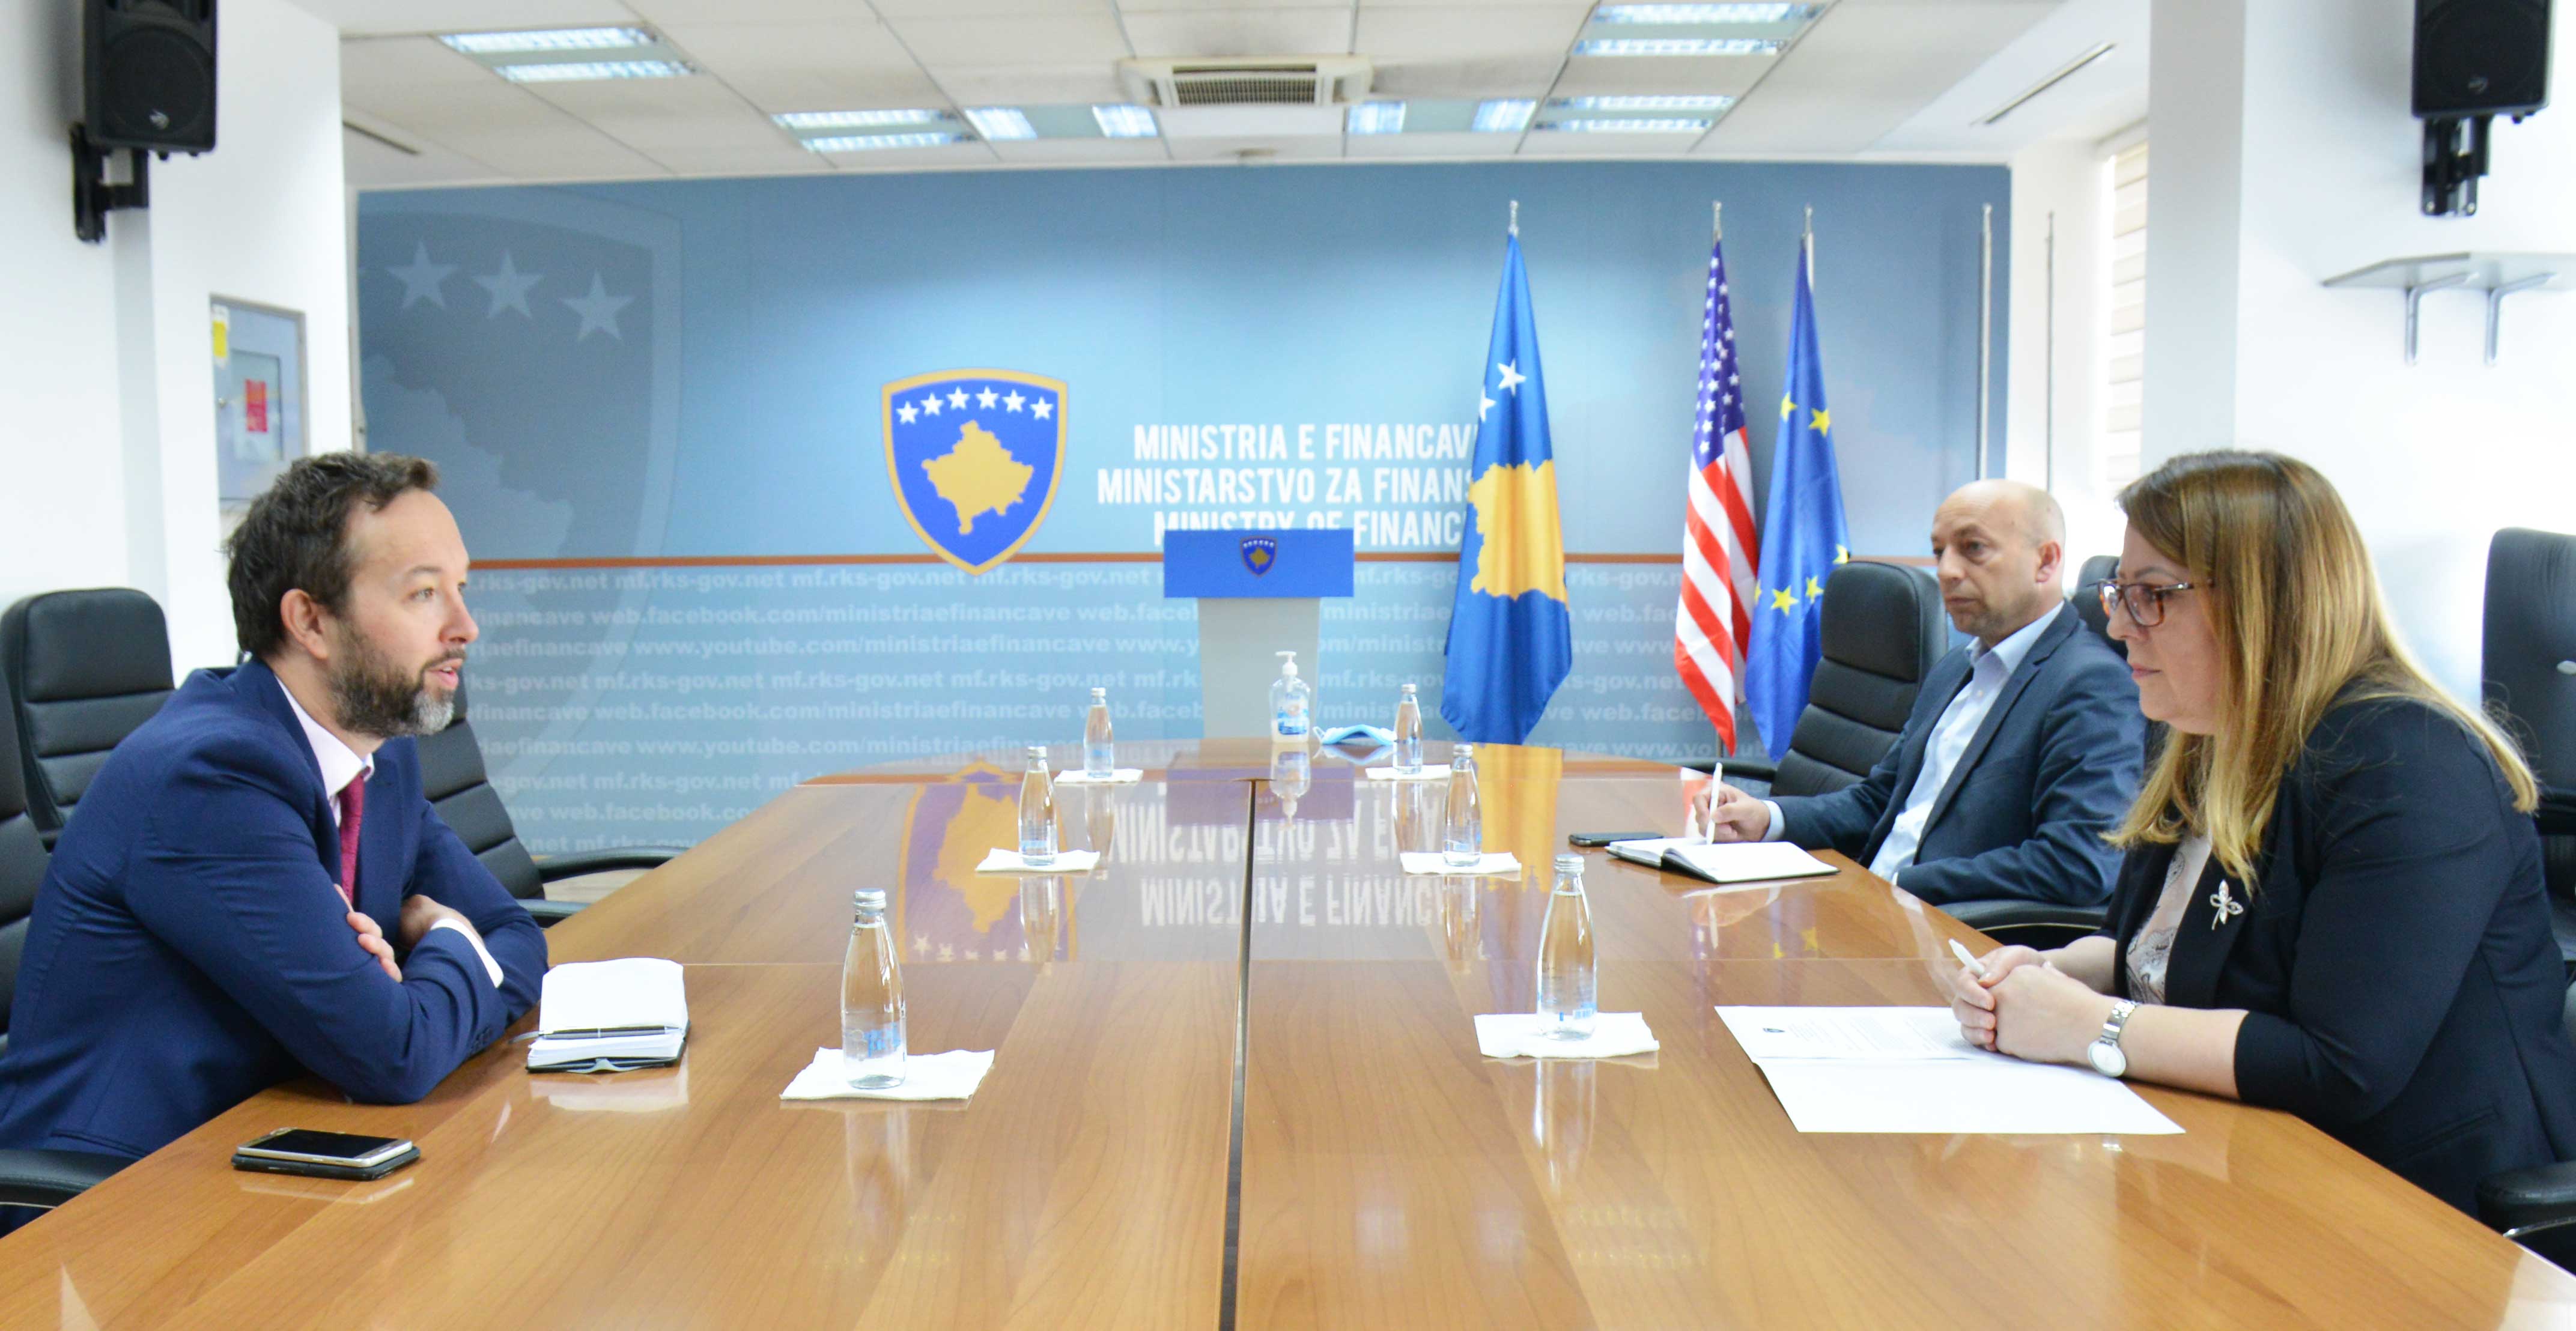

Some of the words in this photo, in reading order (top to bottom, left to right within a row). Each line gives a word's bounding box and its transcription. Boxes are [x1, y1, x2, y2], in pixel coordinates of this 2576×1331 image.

[1134, 424, 1288, 461] MINISTRIA
[1298, 423, 1316, 460] E
[1325, 423, 1478, 460] FINANCAV
[1097, 467, 1316, 504] MINISTARSTVO
[1325, 467, 1364, 503] ZA
[1353, 511, 1466, 546] FINANC
[616, 570, 783, 592] mf.rks-gov.net
[792, 568, 967, 590] mf.rks-gov.net
[591, 602, 1071, 625] web.facebook.com/ministriaefinancave
[634, 634, 1110, 659] www.youtube.com/ministriaefinancave
[595, 671, 764, 694] mf.rks-gov.net
[771, 669, 943, 693] mf.rks-gov.net
[950, 669, 1126, 692] mf.rks-gov.net
[594, 700, 1073, 721] web.facebook.com/ministriaefinancave
